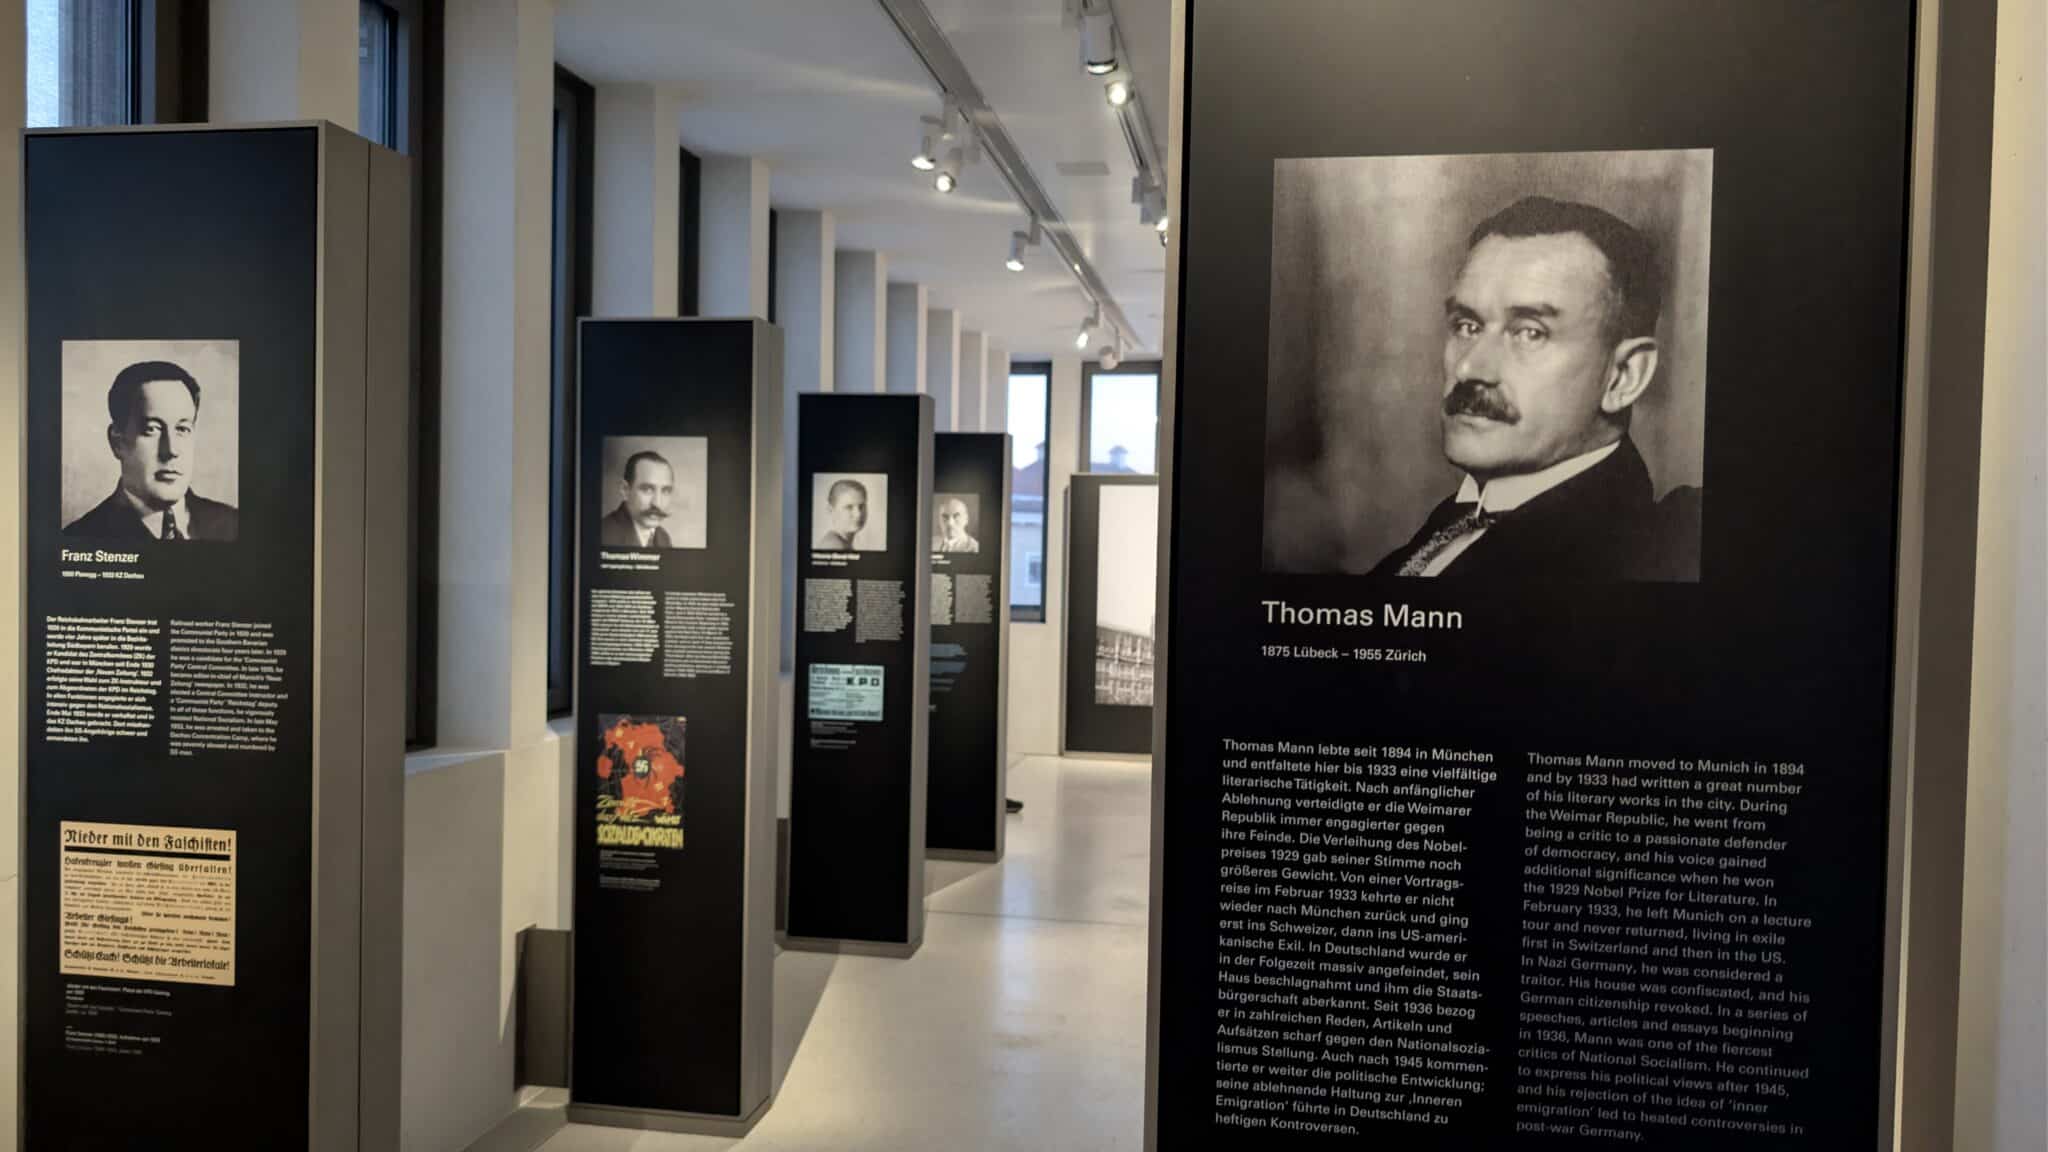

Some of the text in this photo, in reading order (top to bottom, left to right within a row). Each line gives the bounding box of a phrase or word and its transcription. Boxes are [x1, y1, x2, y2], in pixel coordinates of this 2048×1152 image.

[62, 549, 139, 563] Franz Stenzer
[1261, 600, 1463, 629] Thomas Mann
[1261, 645, 1290, 657] 1875
[1293, 645, 1339, 660] Lübeck
[1353, 648, 1382, 661] 1955
[1385, 649, 1427, 662] Zürich
[1223, 738, 1493, 762] Thomas Mann lebte seit 1894 in München
[1223, 756, 1497, 783] und entfaltete hier bis 1933 eine vielfältige
[1528, 752, 1804, 775] Thomas Mann moved to Munich in 1894
[1222, 773, 1475, 801] literarische Tätigkeit. Nach anfänglicher
[1527, 770, 1802, 794] and by 1933 had written a great number
[1222, 791, 1472, 816] Ablehnung verteidigte er die Weimarer
[1526, 788, 1787, 816] of his literary works in the city. During
[1222, 809, 1445, 837] Republik immer engagierter gegen
[1526, 807, 1766, 830] the Weimar Republic, he went from
[64, 829, 109, 845] Nieder
[112, 832, 133, 846] mit
[137, 833, 160, 848] den
[1222, 827, 1467, 853] ihre Feinde. Die Verleihung des Nobel-
[1525, 825, 1787, 850] being a critic to a passionate defender
[1221, 845, 1462, 871] preises 1929 gab seiner Stimme noch
[1524, 844, 1767, 871] of democracy, and his voice gained
[1220, 863, 1464, 892] größeres Gewicht. Von einer Vortrags-
[1524, 862, 1774, 888] additional significance when he won
[1220, 880, 1455, 907] reise im Februar 1933 kehrte er nicht
[1524, 880, 1777, 907] the 1929 Nobel Prize for Literature. In
[1220, 898, 1469, 929] wieder nach München zurück und ging
[1219, 918, 1467, 944] erst ins Schweizer, dann ins US-ameri-
[1216, 1111, 1359, 1135] heftigen Kontroversen.
